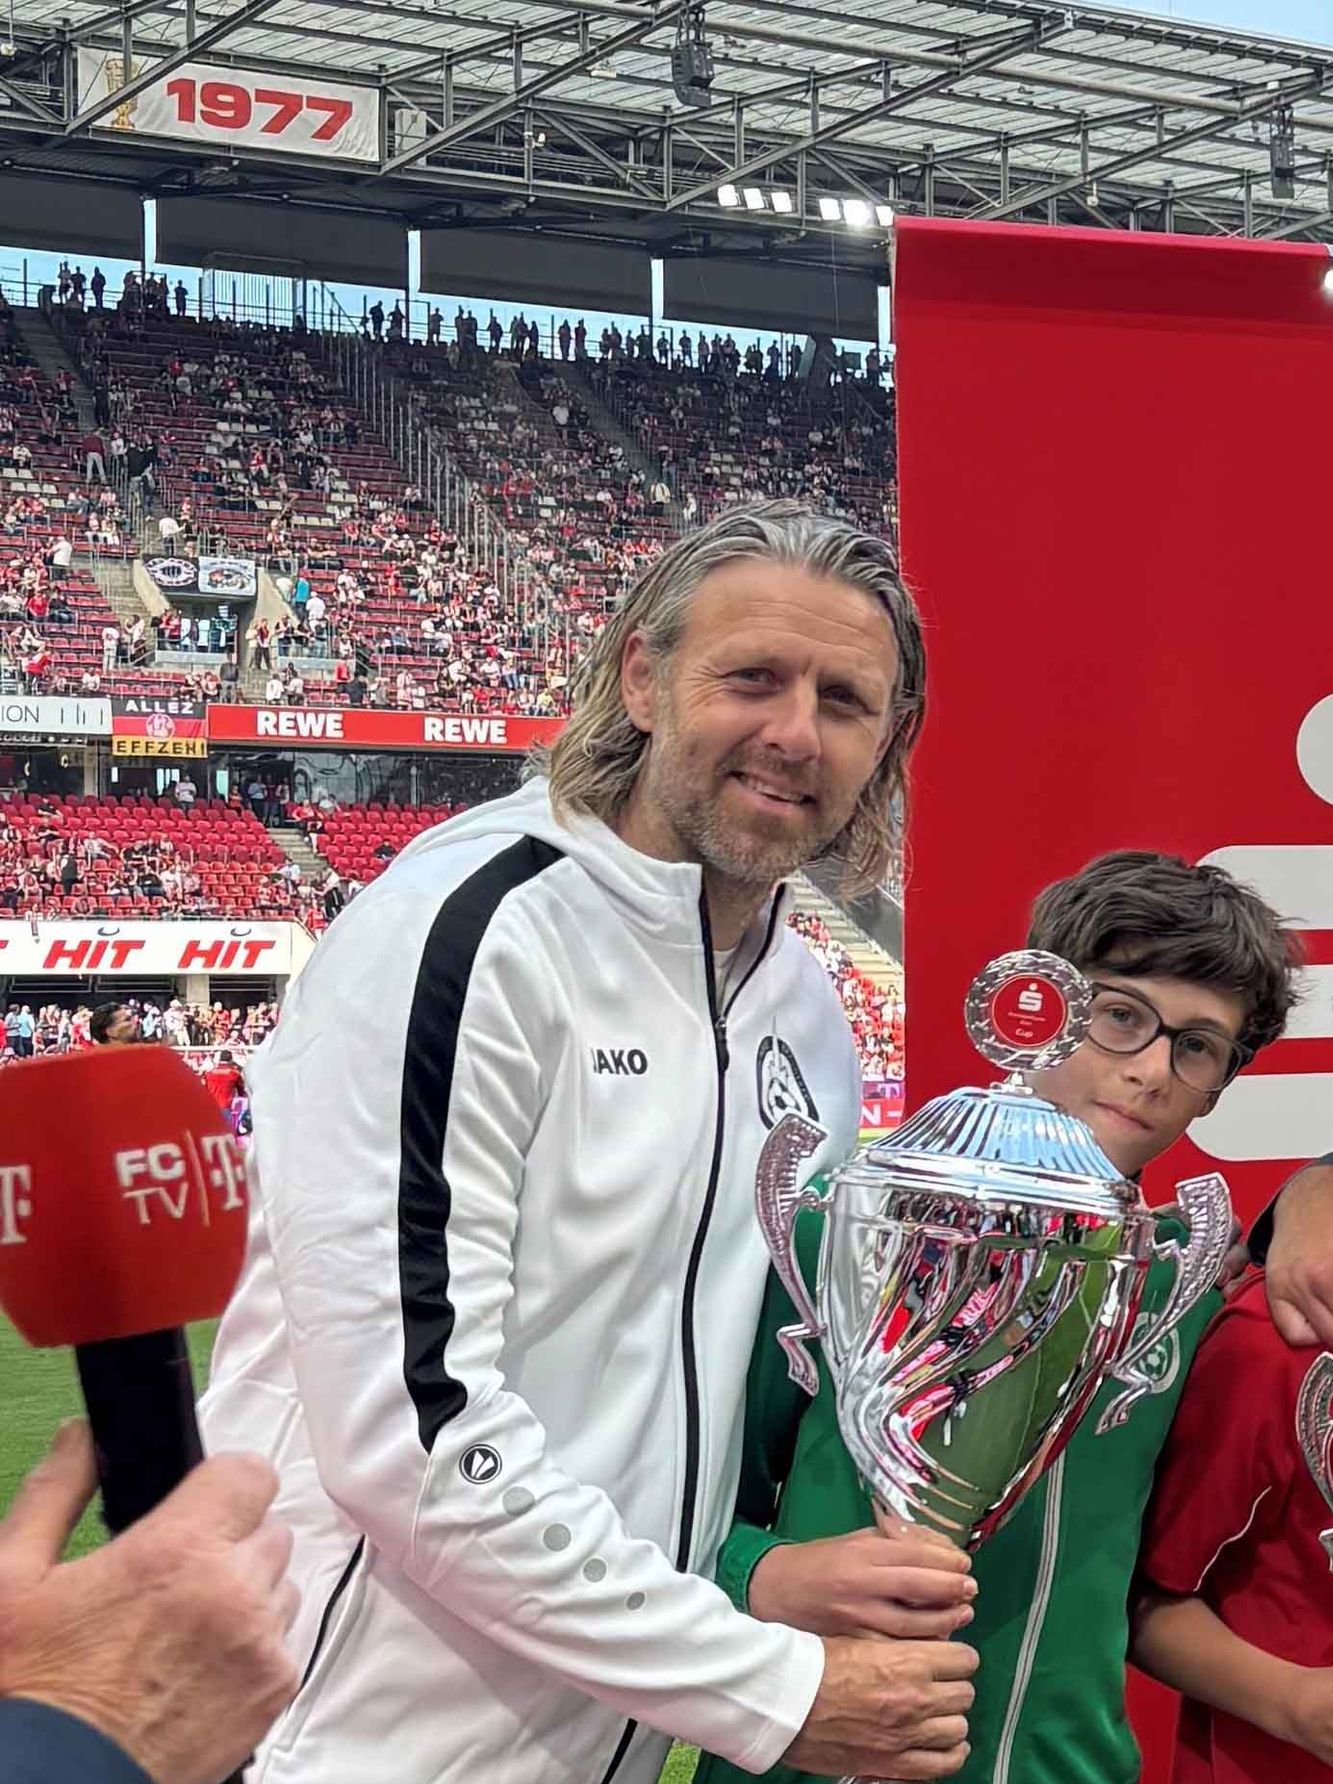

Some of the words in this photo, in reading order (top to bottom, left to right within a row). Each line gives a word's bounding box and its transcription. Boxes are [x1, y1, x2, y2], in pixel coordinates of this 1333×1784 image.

[166, 77, 353, 141] 1977
[125, 700, 194, 715] ALLEZ
[256, 710, 345, 739] REWE
[424, 717, 508, 745] REWE
[43, 940, 146, 969] HIT
[177, 940, 276, 969] HIT
[115, 1143, 186, 1187] FC
[123, 1182, 189, 1225] TV
